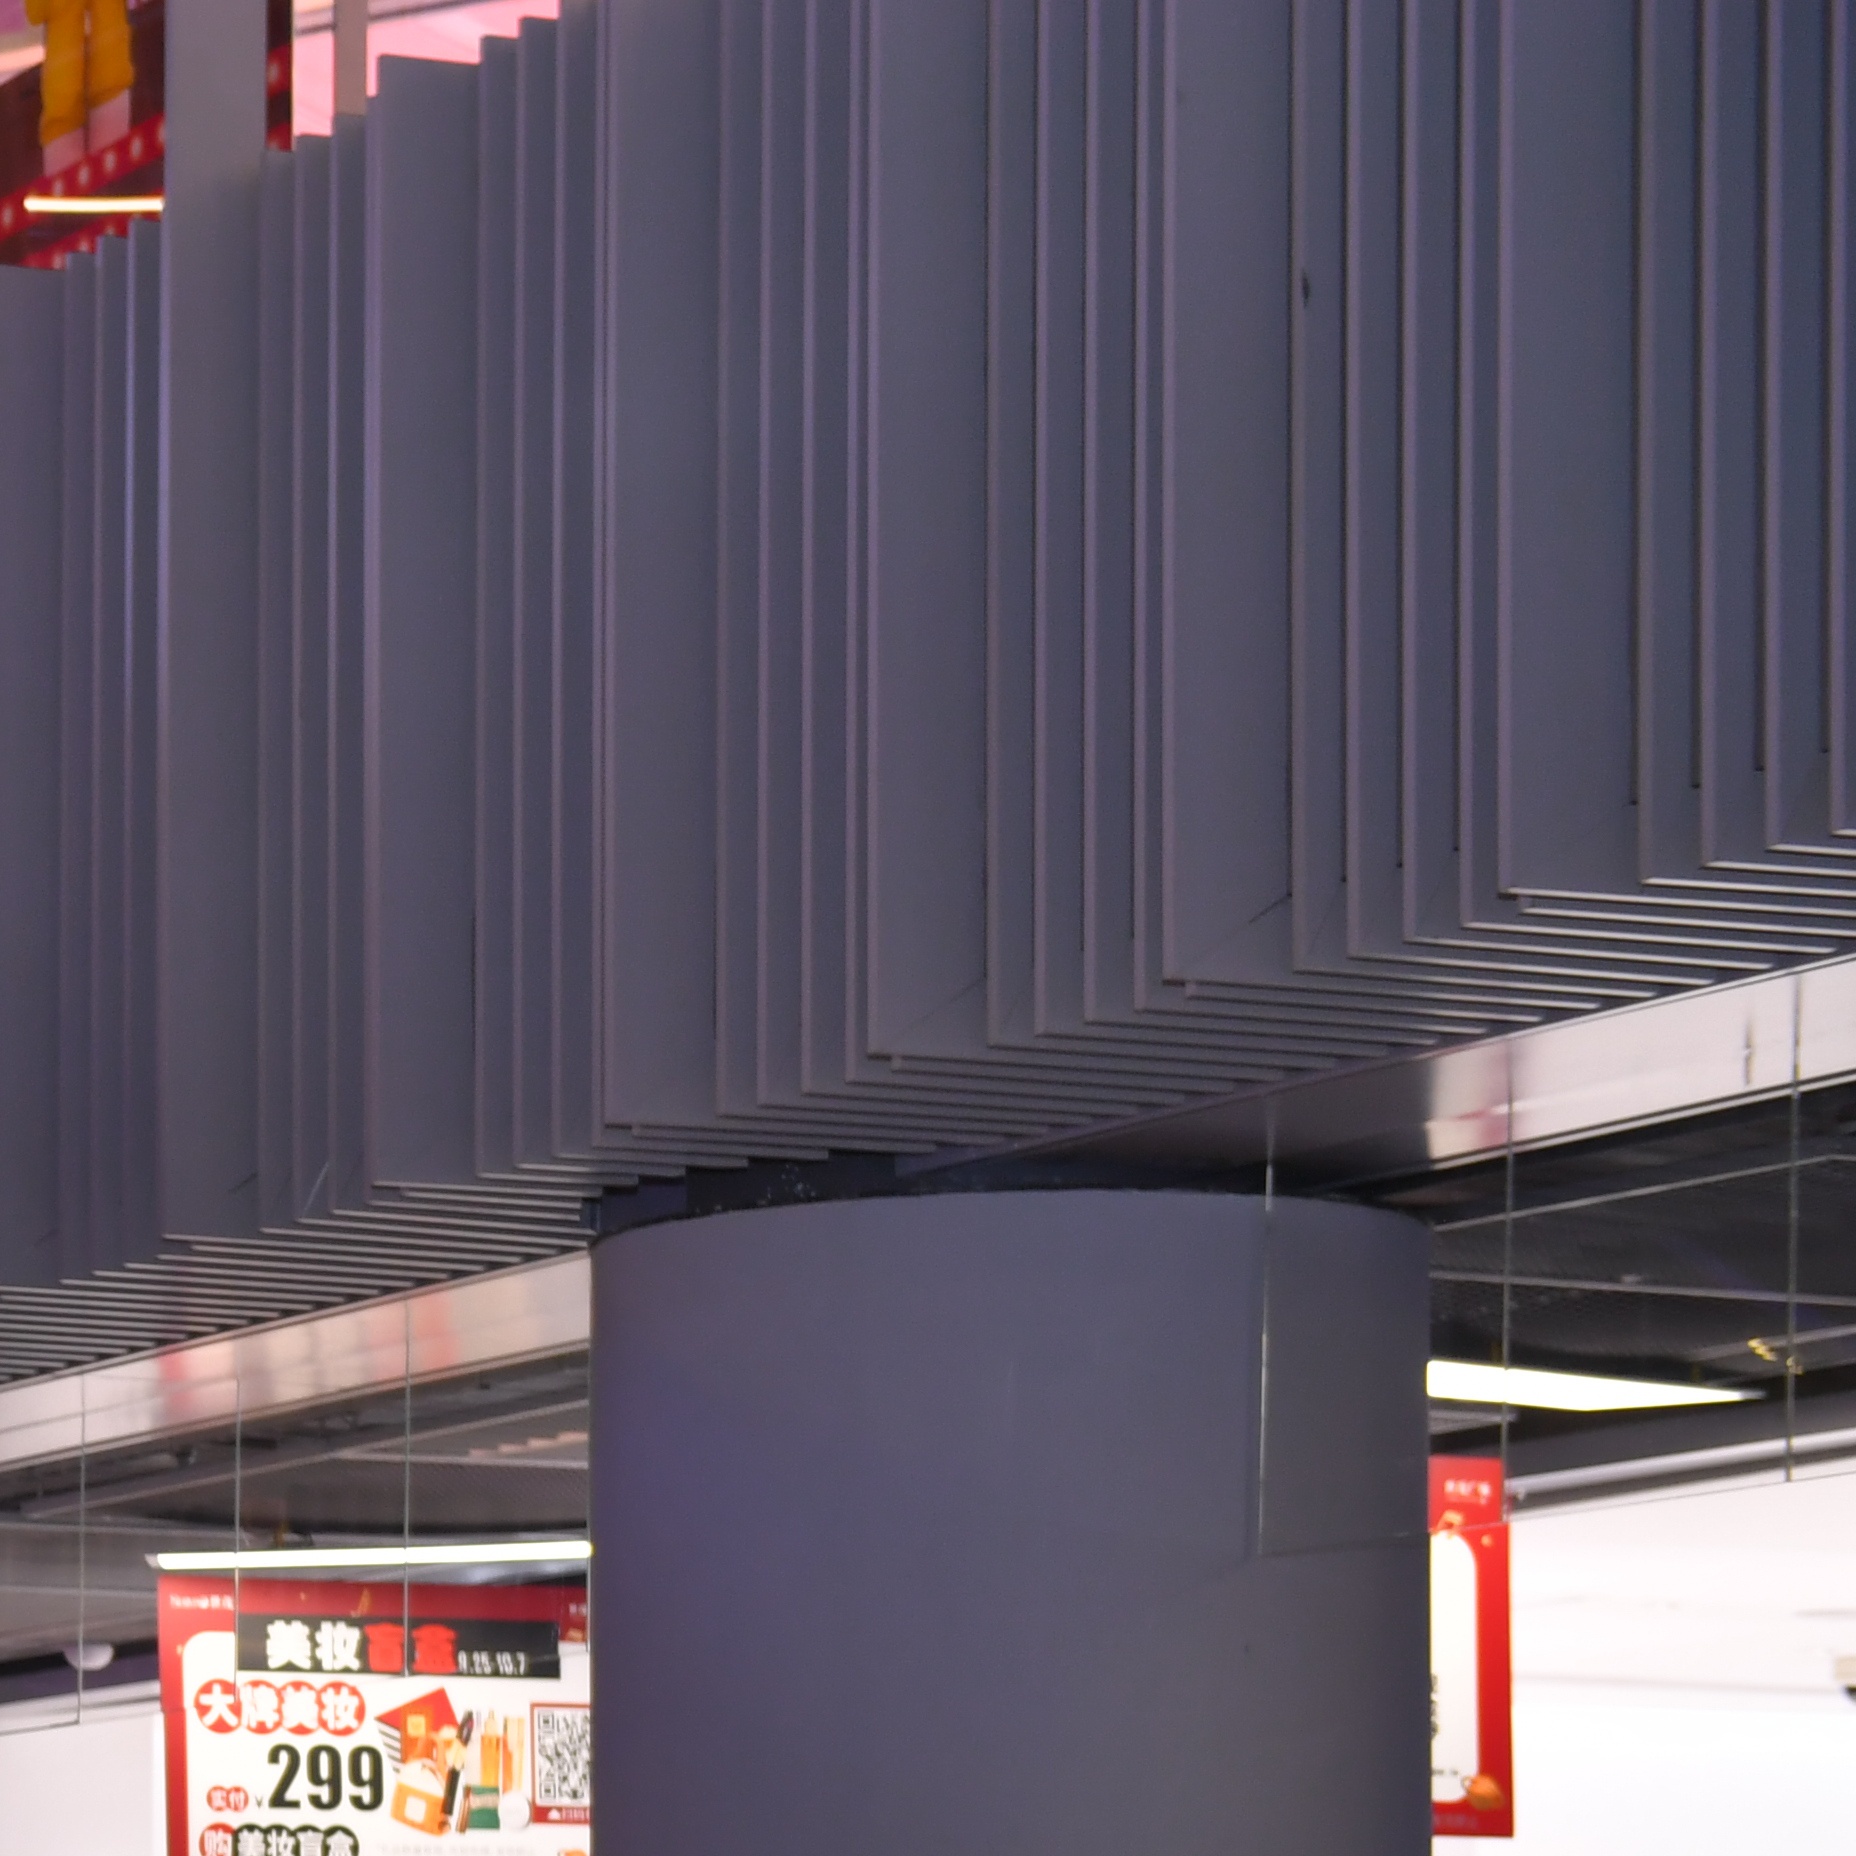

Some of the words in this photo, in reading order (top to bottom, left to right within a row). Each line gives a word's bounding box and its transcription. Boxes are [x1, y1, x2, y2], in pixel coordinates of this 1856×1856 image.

[266, 1619, 457, 1674] 美妆盲盒
[199, 1683, 361, 1732] 大牌美妆
